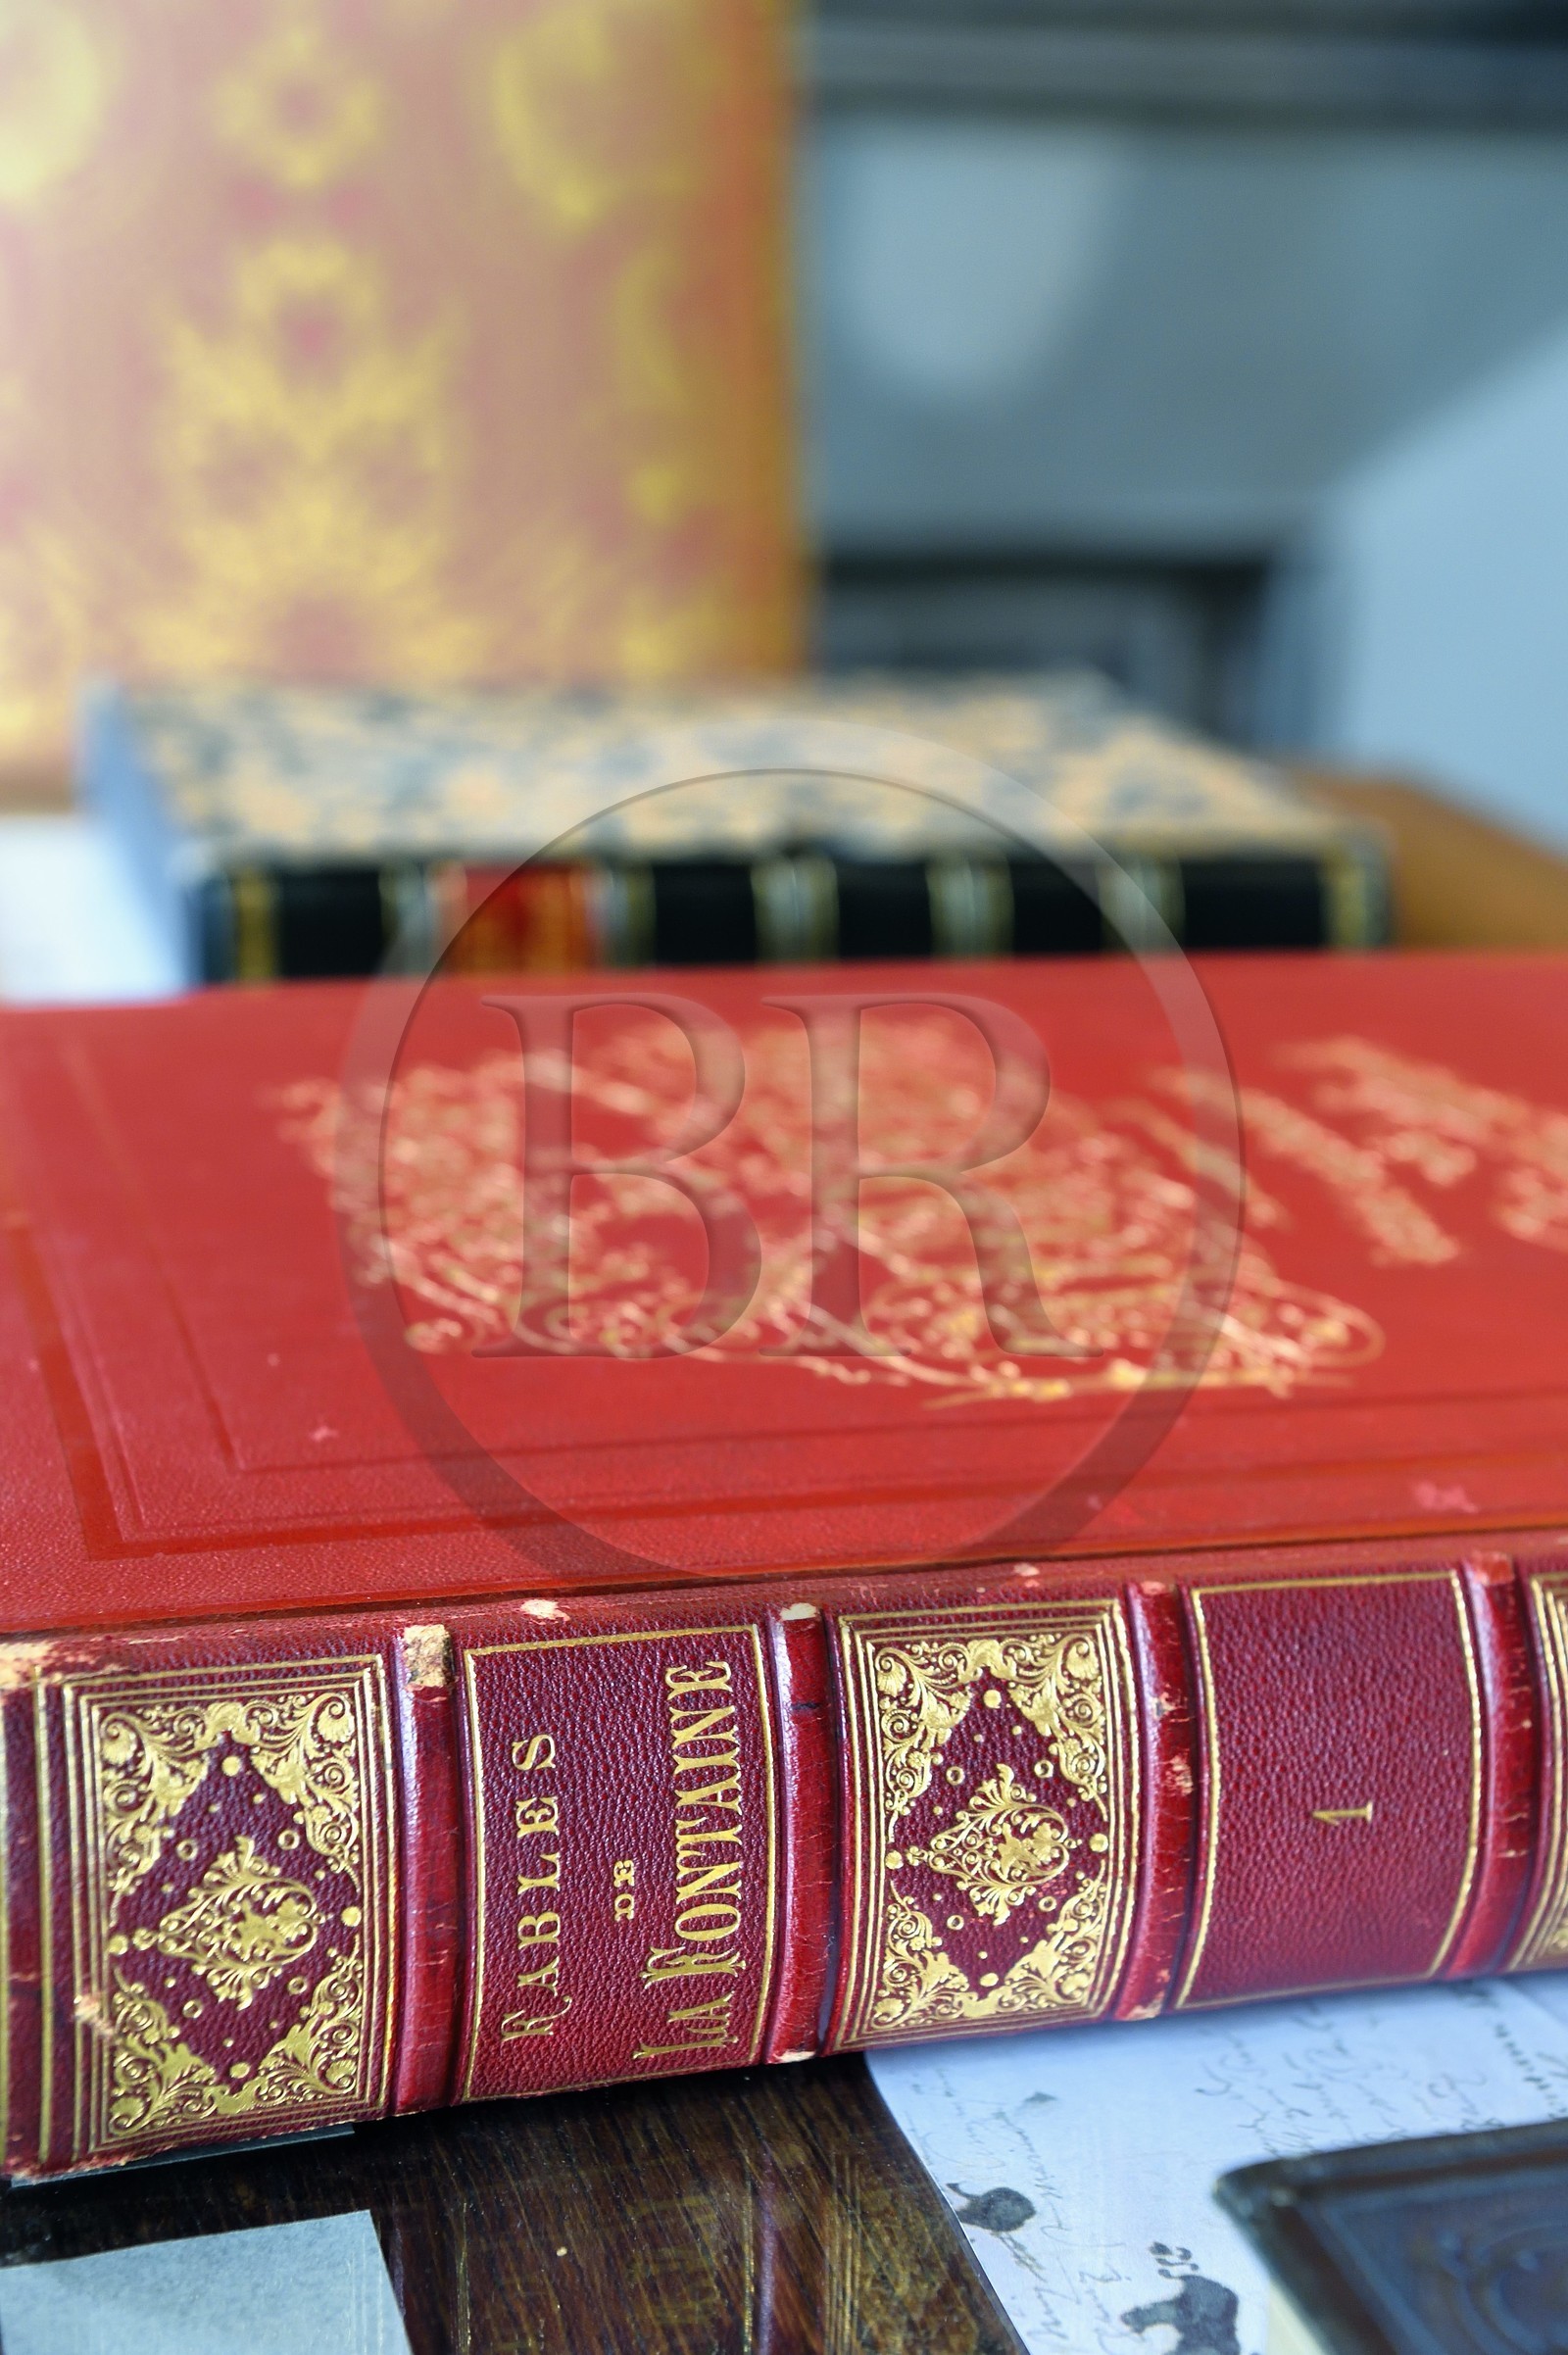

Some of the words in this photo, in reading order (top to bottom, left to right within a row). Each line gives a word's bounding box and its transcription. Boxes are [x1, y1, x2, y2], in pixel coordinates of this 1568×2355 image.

[639, 1659, 747, 1989] FONTAINE
[1311, 1800, 1373, 1827] 1
[500, 1733, 573, 2042] FABLES
[612, 1859, 636, 1922] DE
[632, 1990, 740, 2060] LA
